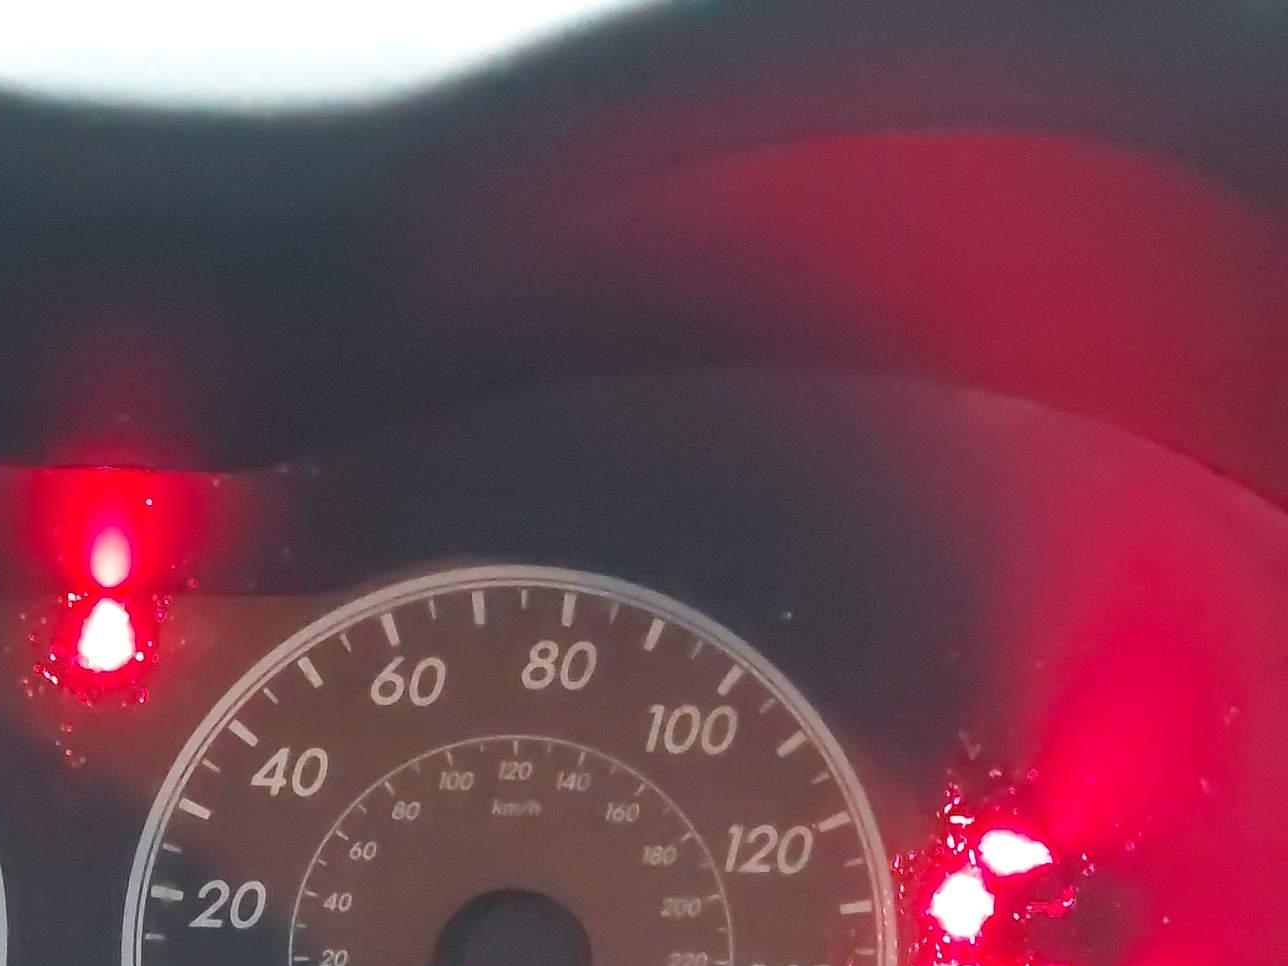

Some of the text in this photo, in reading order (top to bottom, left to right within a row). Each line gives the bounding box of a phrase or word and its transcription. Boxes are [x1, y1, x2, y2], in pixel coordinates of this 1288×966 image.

[521, 641, 597, 689] 80
[370, 658, 445, 707] 60
[646, 704, 737, 755] 100
[251, 747, 328, 796] 40
[437, 770, 474, 791] 100
[497, 760, 533, 780] 120
[556, 770, 591, 791] 140
[392, 801, 421, 821] 80
[604, 802, 641, 822] 160
[349, 841, 377, 861] 60
[642, 845, 677, 865] 180
[724, 825, 813, 874] 120
[188, 881, 266, 929] 20
[323, 891, 352, 912] 40
[660, 897, 702, 918] 200
